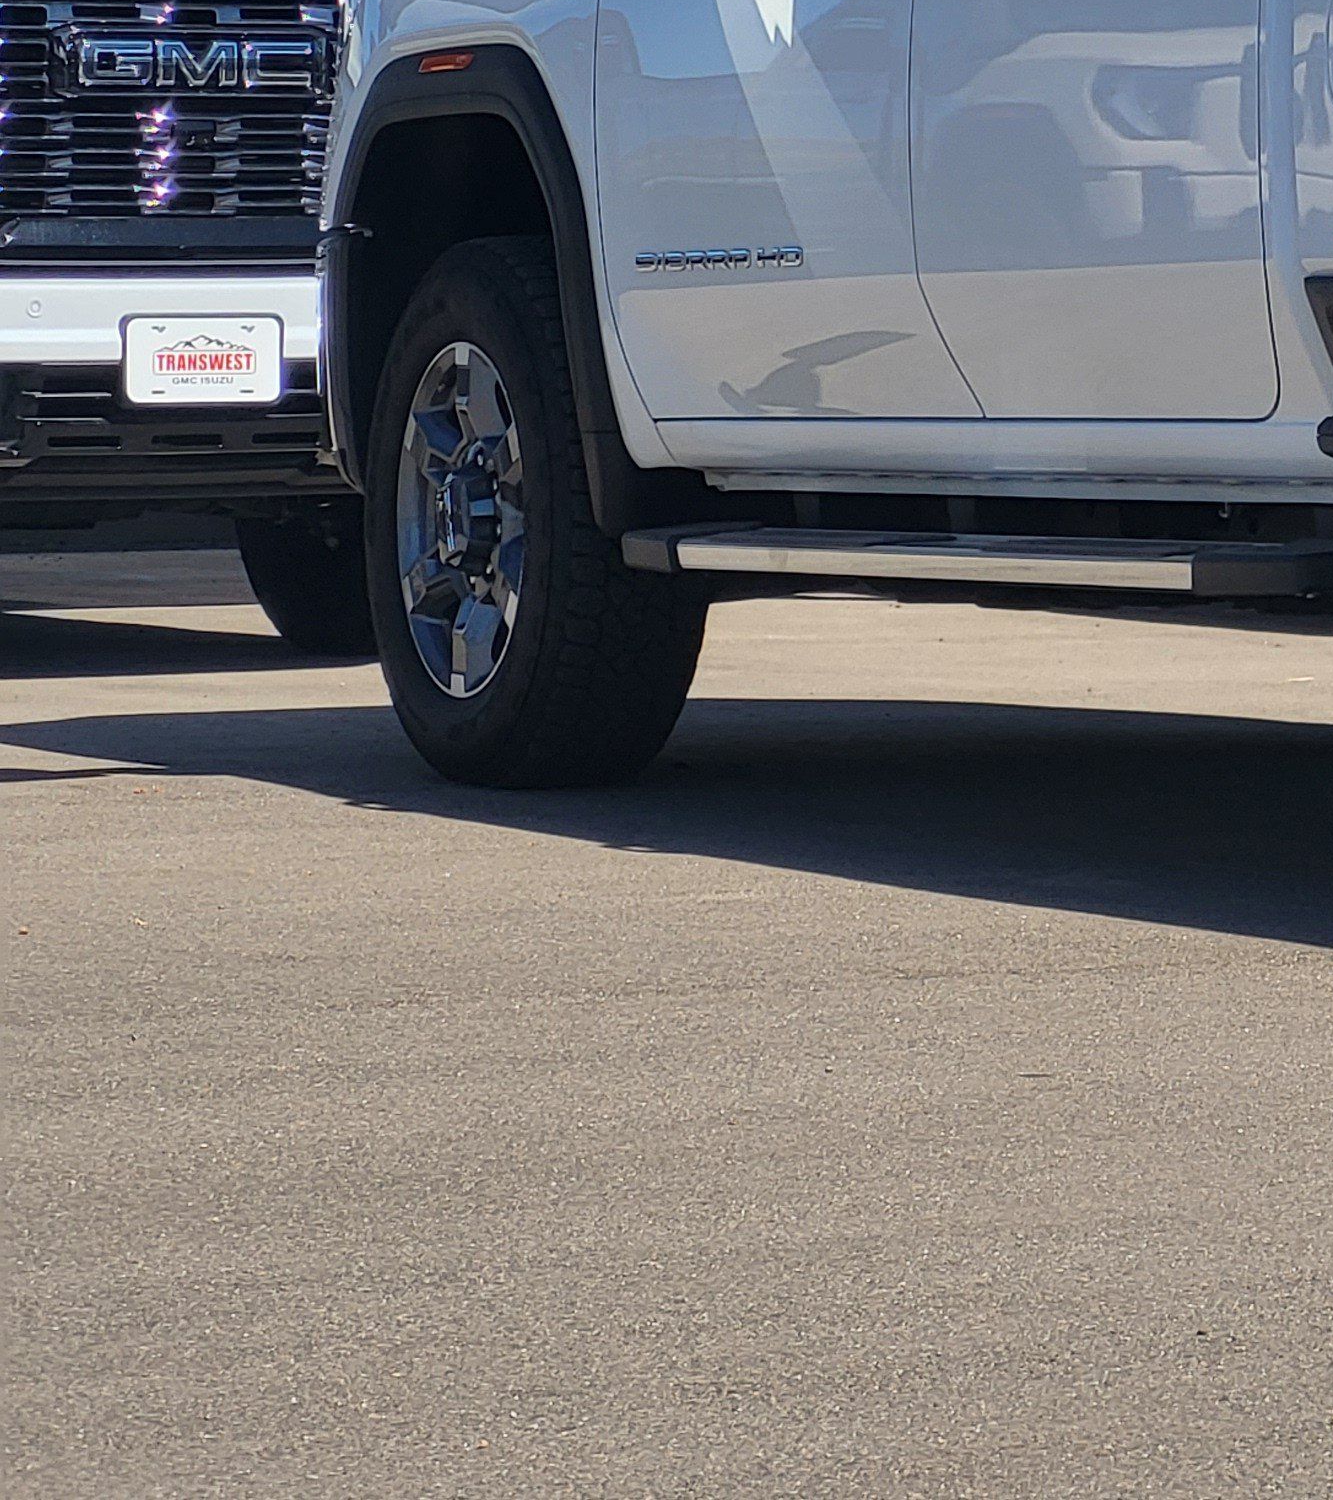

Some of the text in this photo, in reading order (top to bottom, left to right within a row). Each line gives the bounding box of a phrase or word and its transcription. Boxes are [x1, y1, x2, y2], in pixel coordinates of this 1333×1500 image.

[79, 40, 312, 87] GMC
[635, 246, 804, 273] SIERRA HD
[157, 353, 253, 372] TRANSWEST
[172, 376, 234, 385] GMC ISUZU
